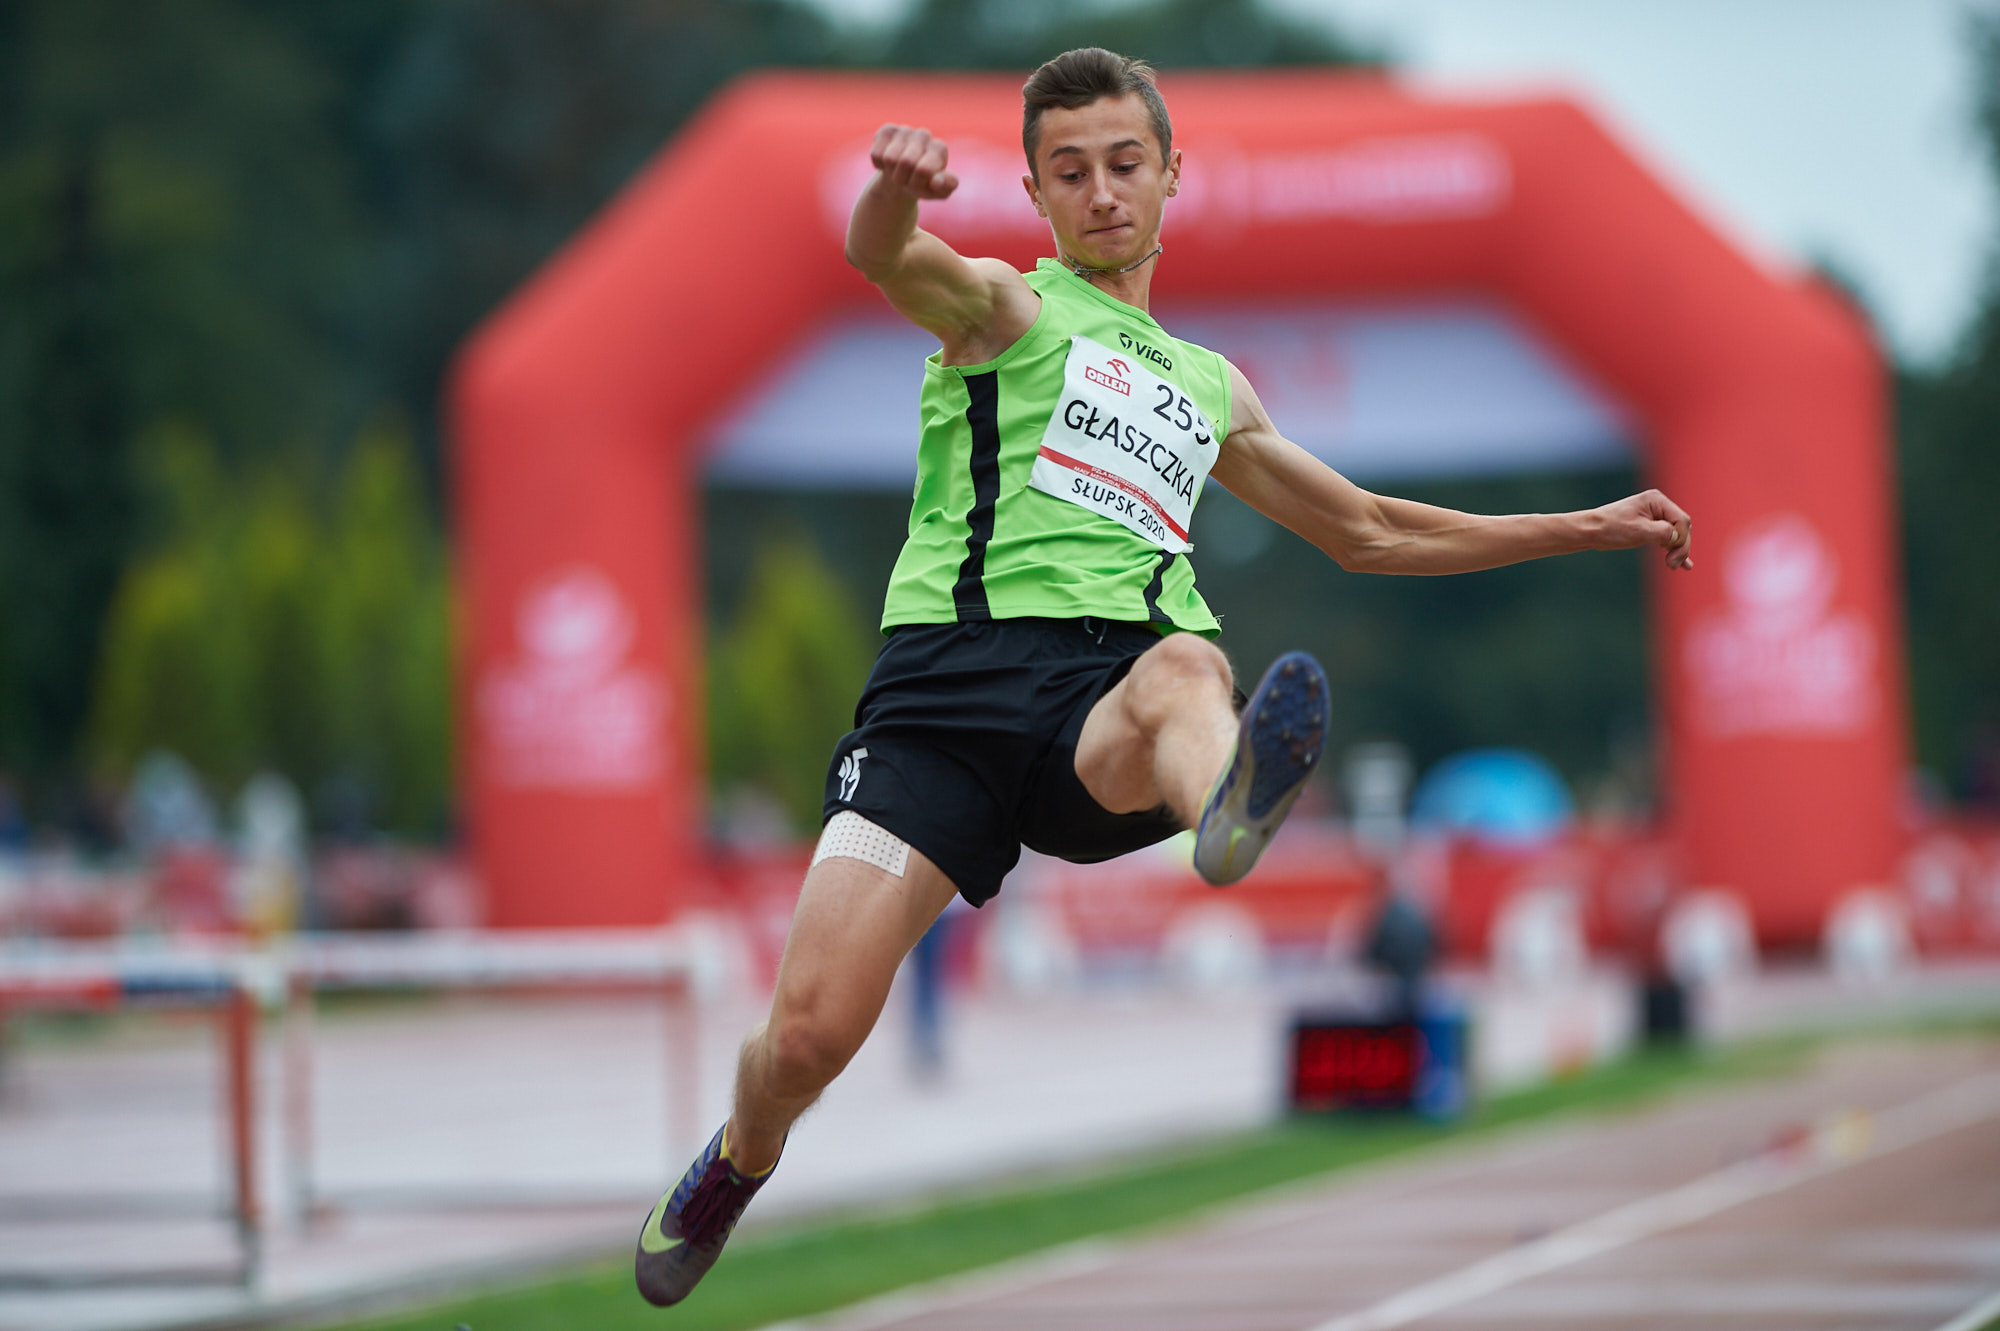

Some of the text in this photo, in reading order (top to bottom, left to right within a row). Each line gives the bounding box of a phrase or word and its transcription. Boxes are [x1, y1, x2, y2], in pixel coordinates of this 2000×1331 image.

[1087, 369, 1129, 394] ORLEN
[1064, 399, 1195, 506] GŁASZCZKA
[1071, 478, 1136, 518] SŁUPSK
[1138, 508, 1165, 541] 2020
